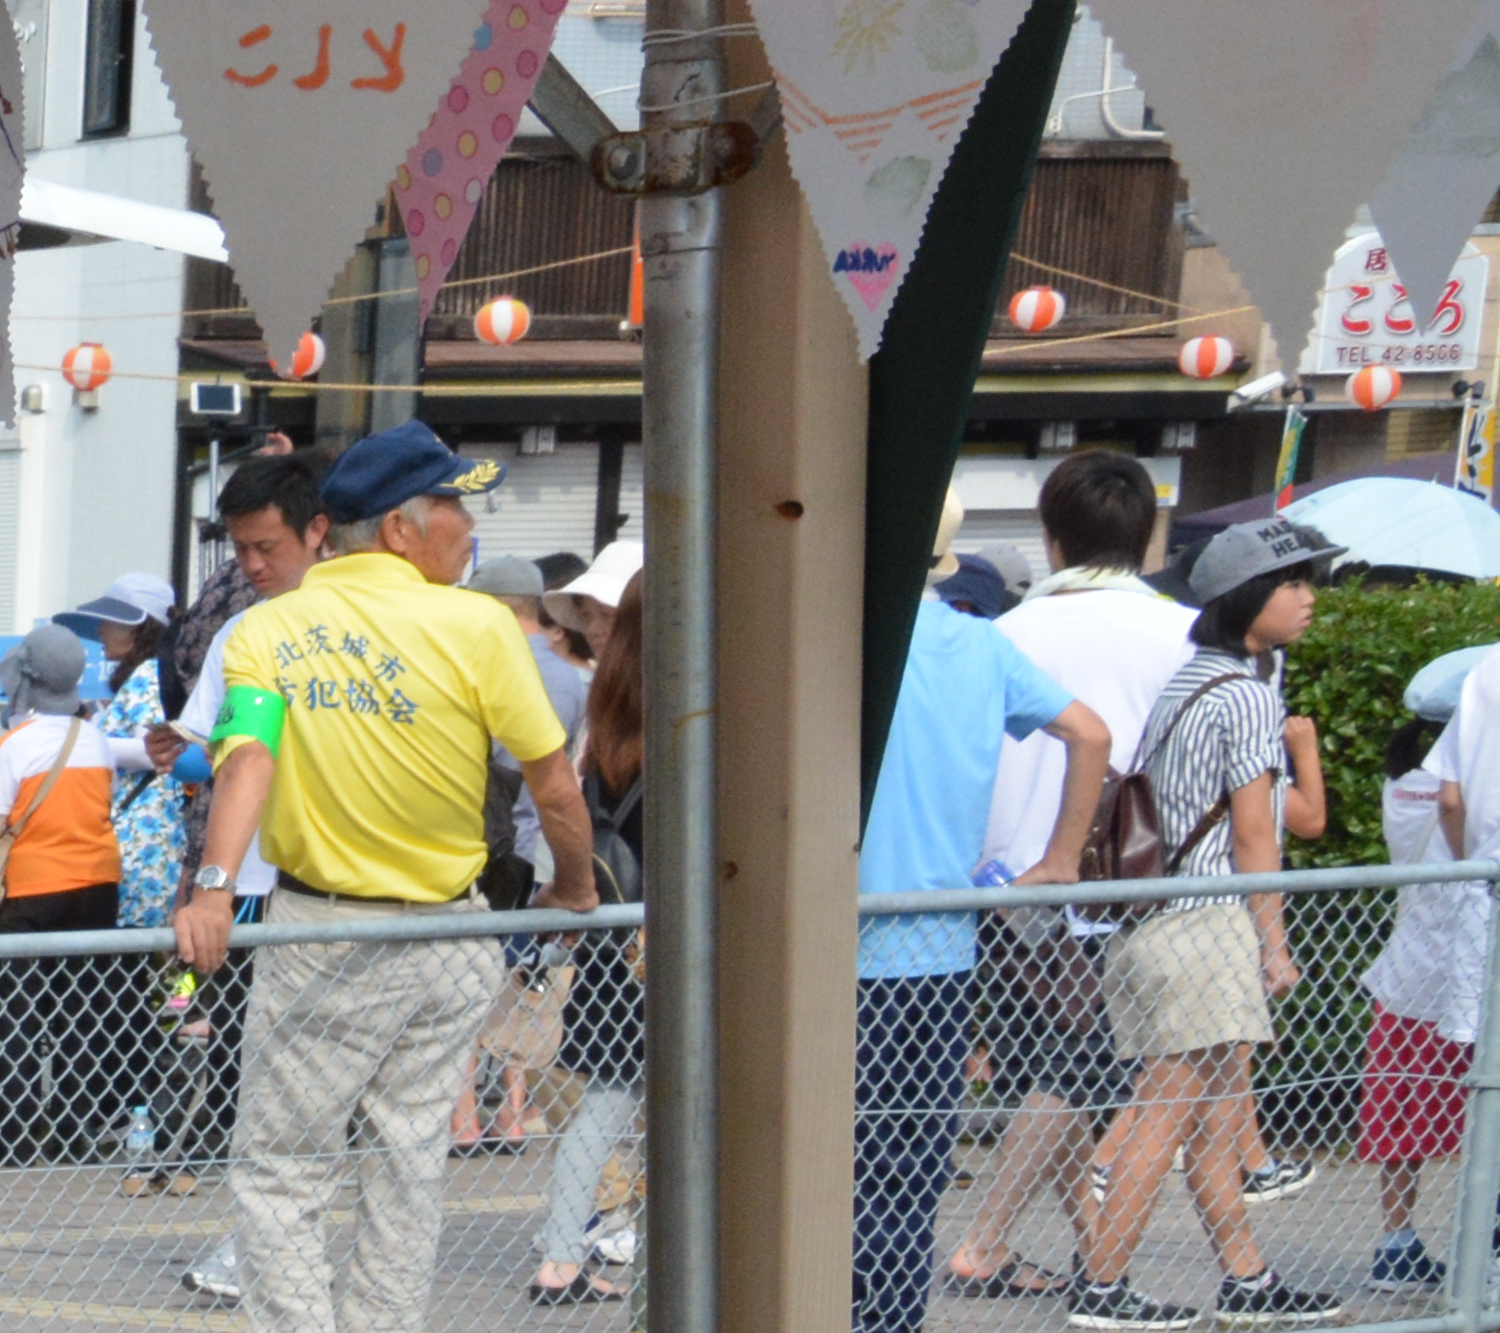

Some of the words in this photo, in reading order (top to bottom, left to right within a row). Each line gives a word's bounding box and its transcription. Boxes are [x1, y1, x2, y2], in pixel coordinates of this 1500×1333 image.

[1336, 347, 1370, 362] TEL
[275, 624, 407, 683] 北茨城市
